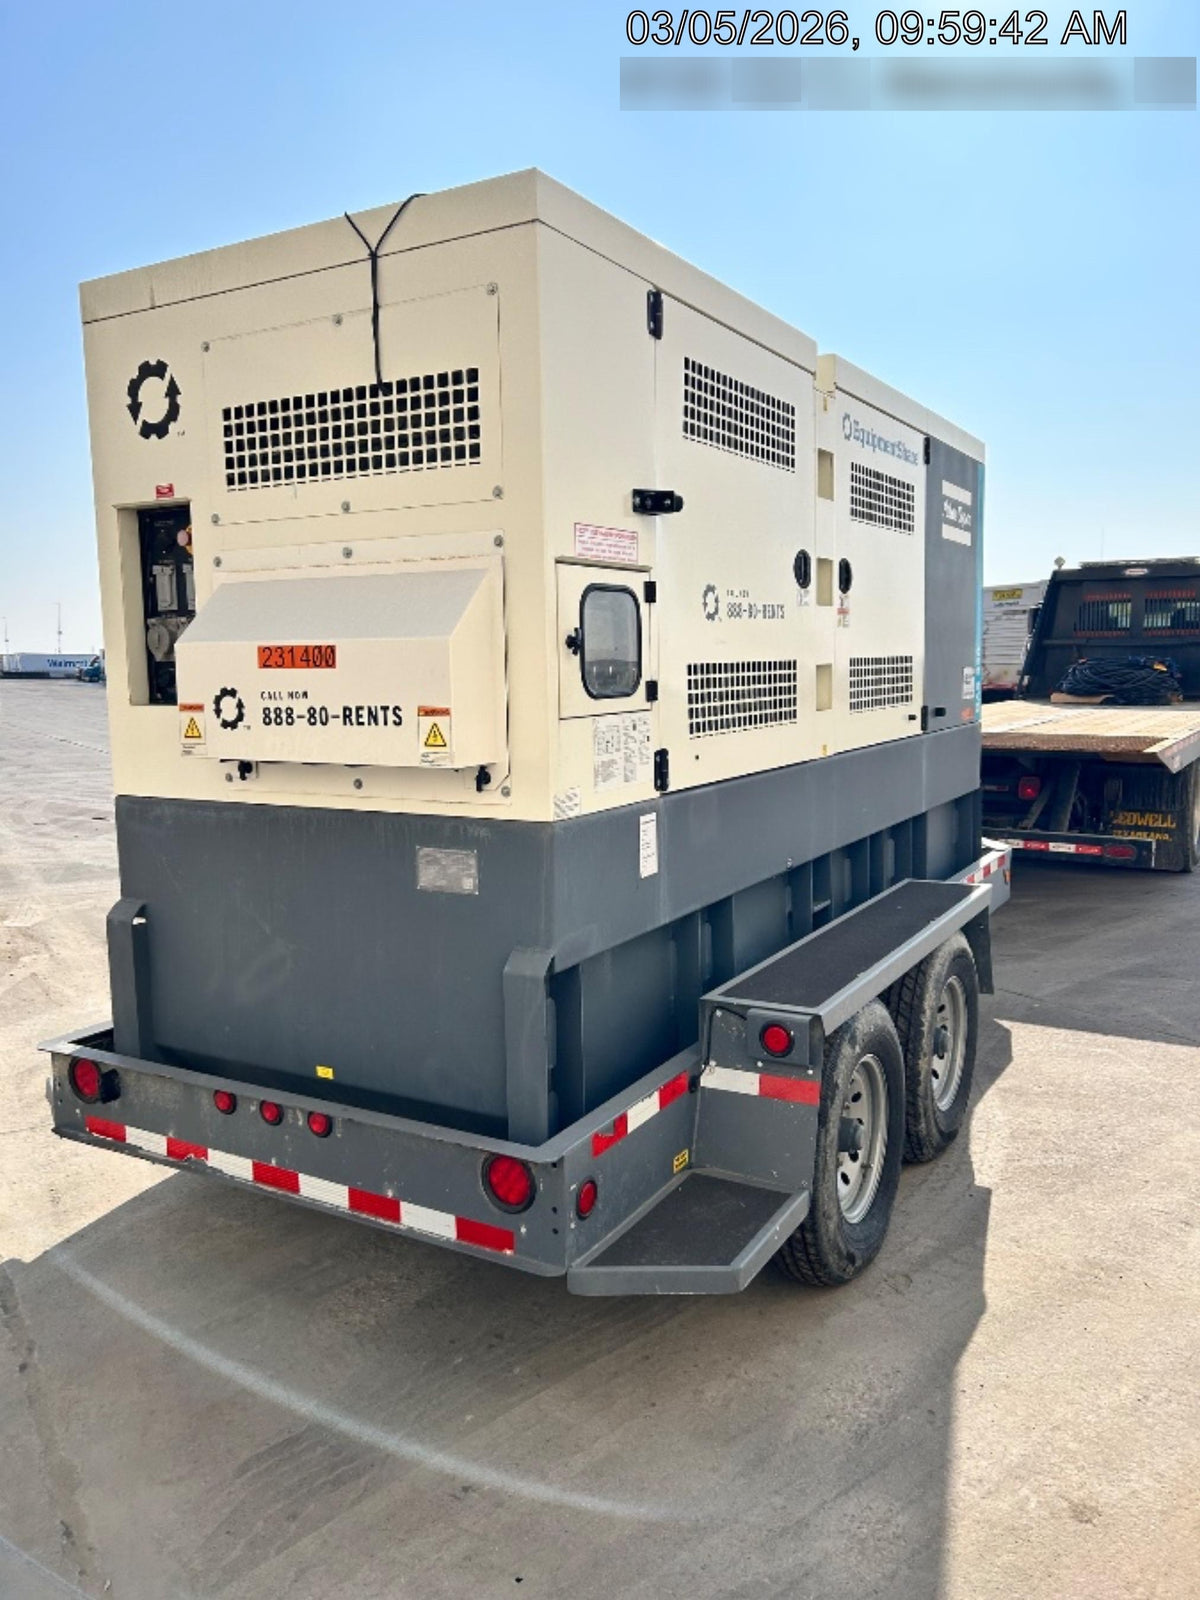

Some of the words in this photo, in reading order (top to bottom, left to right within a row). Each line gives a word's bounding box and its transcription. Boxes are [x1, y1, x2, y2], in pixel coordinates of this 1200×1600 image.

[261, 645, 337, 668] 231400
[260, 691, 283, 701] CALL
[287, 690, 309, 700] NOW
[262, 705, 403, 726] 888-80-RENTS
